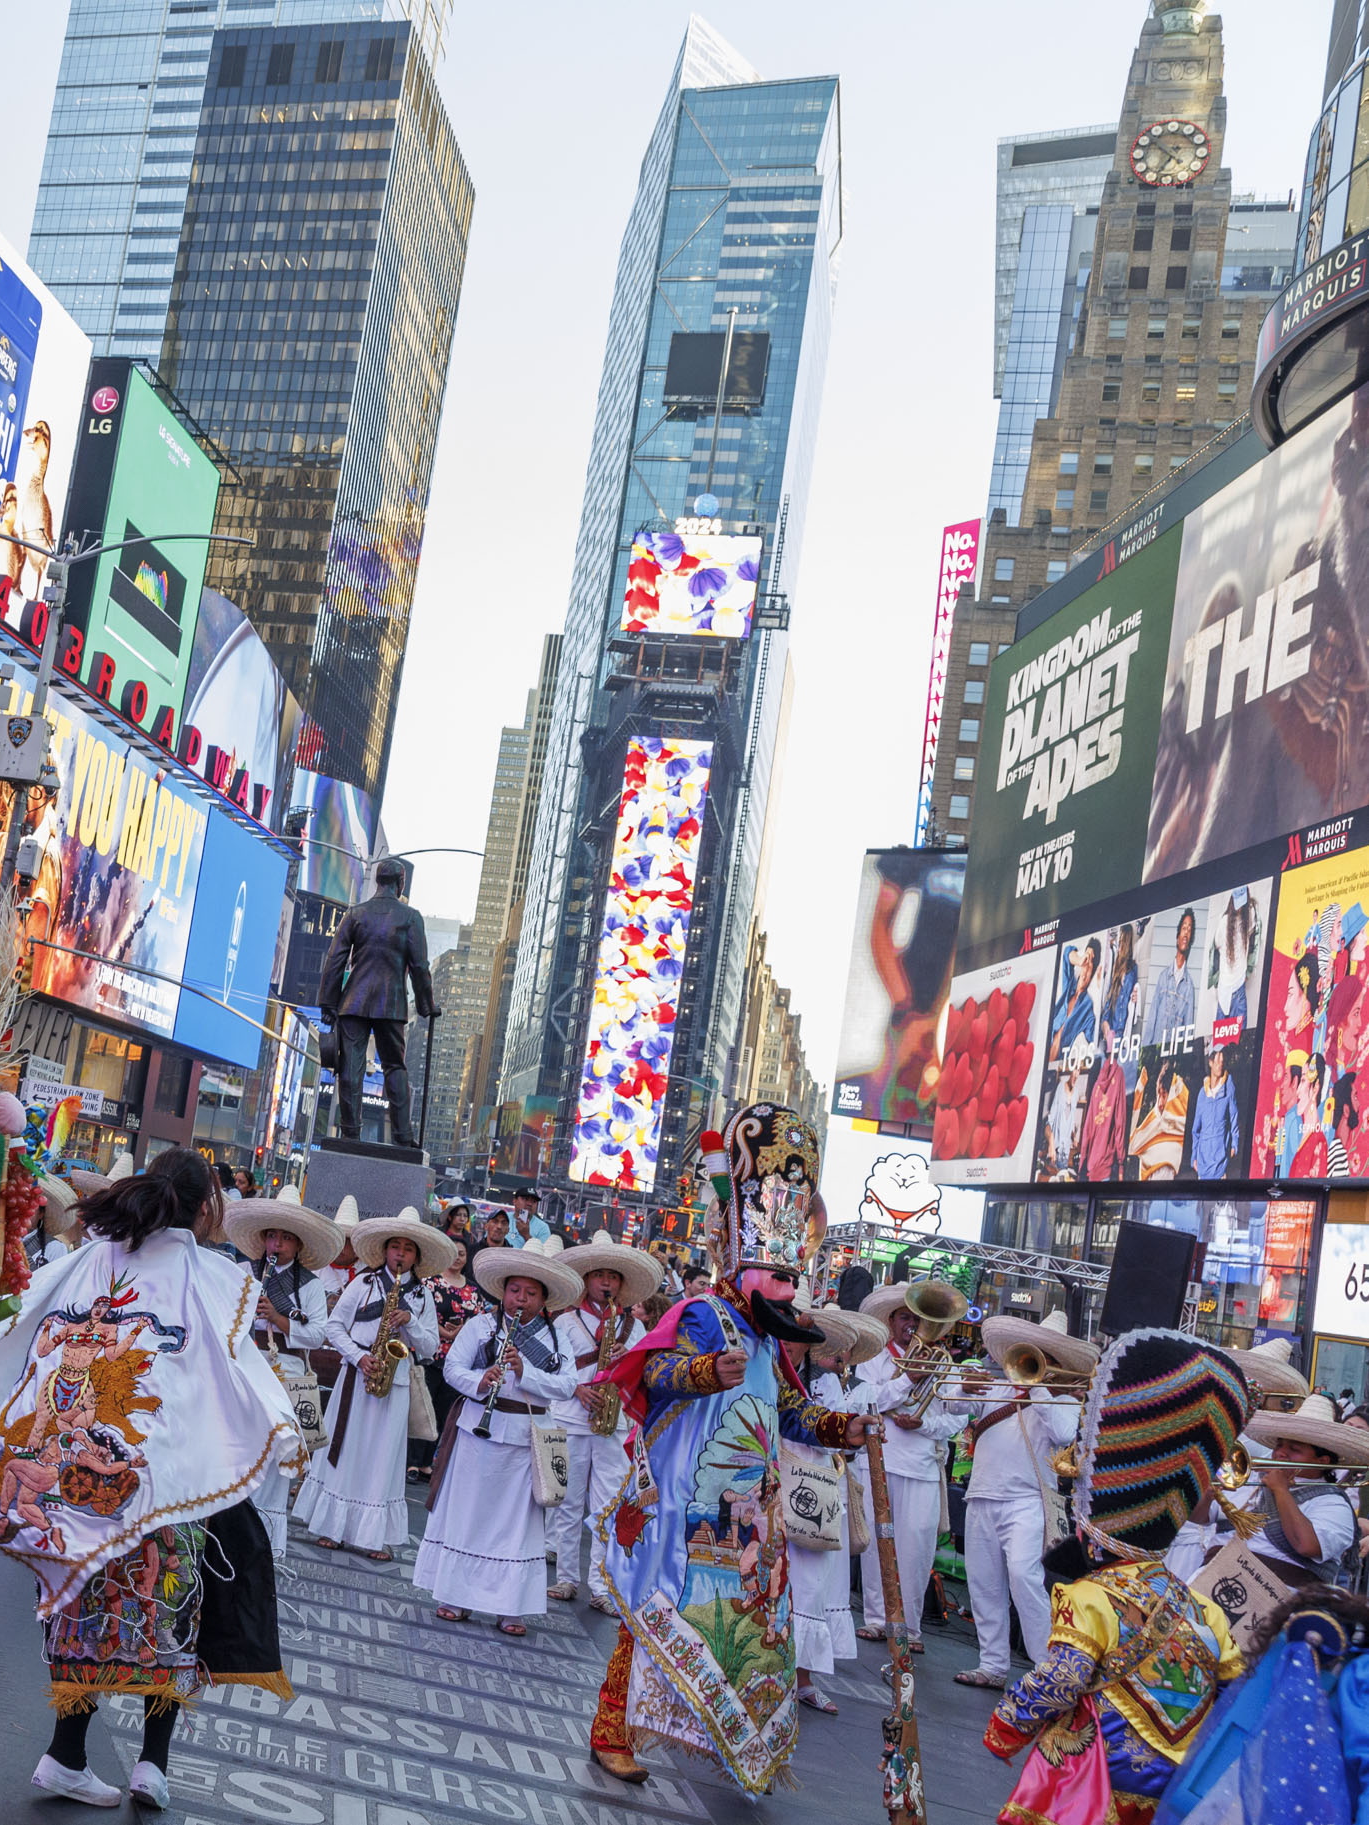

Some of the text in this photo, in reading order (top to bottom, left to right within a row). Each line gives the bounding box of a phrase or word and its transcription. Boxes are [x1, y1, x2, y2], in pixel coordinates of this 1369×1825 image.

[1281, 267, 1361, 337] MARQUIS
[88, 418, 112, 434] LG
[675, 517, 722, 536] 2024
[1121, 503, 1165, 545] MARRIOTT
[944, 531, 976, 554] No.
[1119, 525, 1157, 563] MARQUIS
[942, 552, 973, 575] No.
[1005, 606, 1143, 712] KINGDOM OF THE
[1184, 560, 1322, 735] THE
[996, 630, 1140, 793] PLANET
[1007, 759, 1034, 786] OF THE
[1022, 707, 1125, 826] APES
[66, 727, 126, 857] YOU
[116, 764, 206, 898] HAPPY”
[1307, 817, 1354, 843] MARRIOTT
[1019, 829, 1076, 866] ONLY IN THEATERS
[1305, 835, 1346, 859] MARQUIS
[1015, 845, 1073, 899] MAY 10
[1032, 932, 1055, 948] MARQUIS
[1033, 919, 1060, 937] MARRIOTT
[1062, 1024, 1195, 1072] TOPS FOR LIFE
[33, 1083, 68, 1096] PEDESTRIAN
[84, 1092, 100, 1102] ZONE
[1011, 1292, 1030, 1303] swatch
[791, 1466, 798, 1476] La
[798, 1468, 813, 1479] Banda
[1237, 1554, 1244, 1564] La
[215, 1734, 328, 1775] SQUARE
